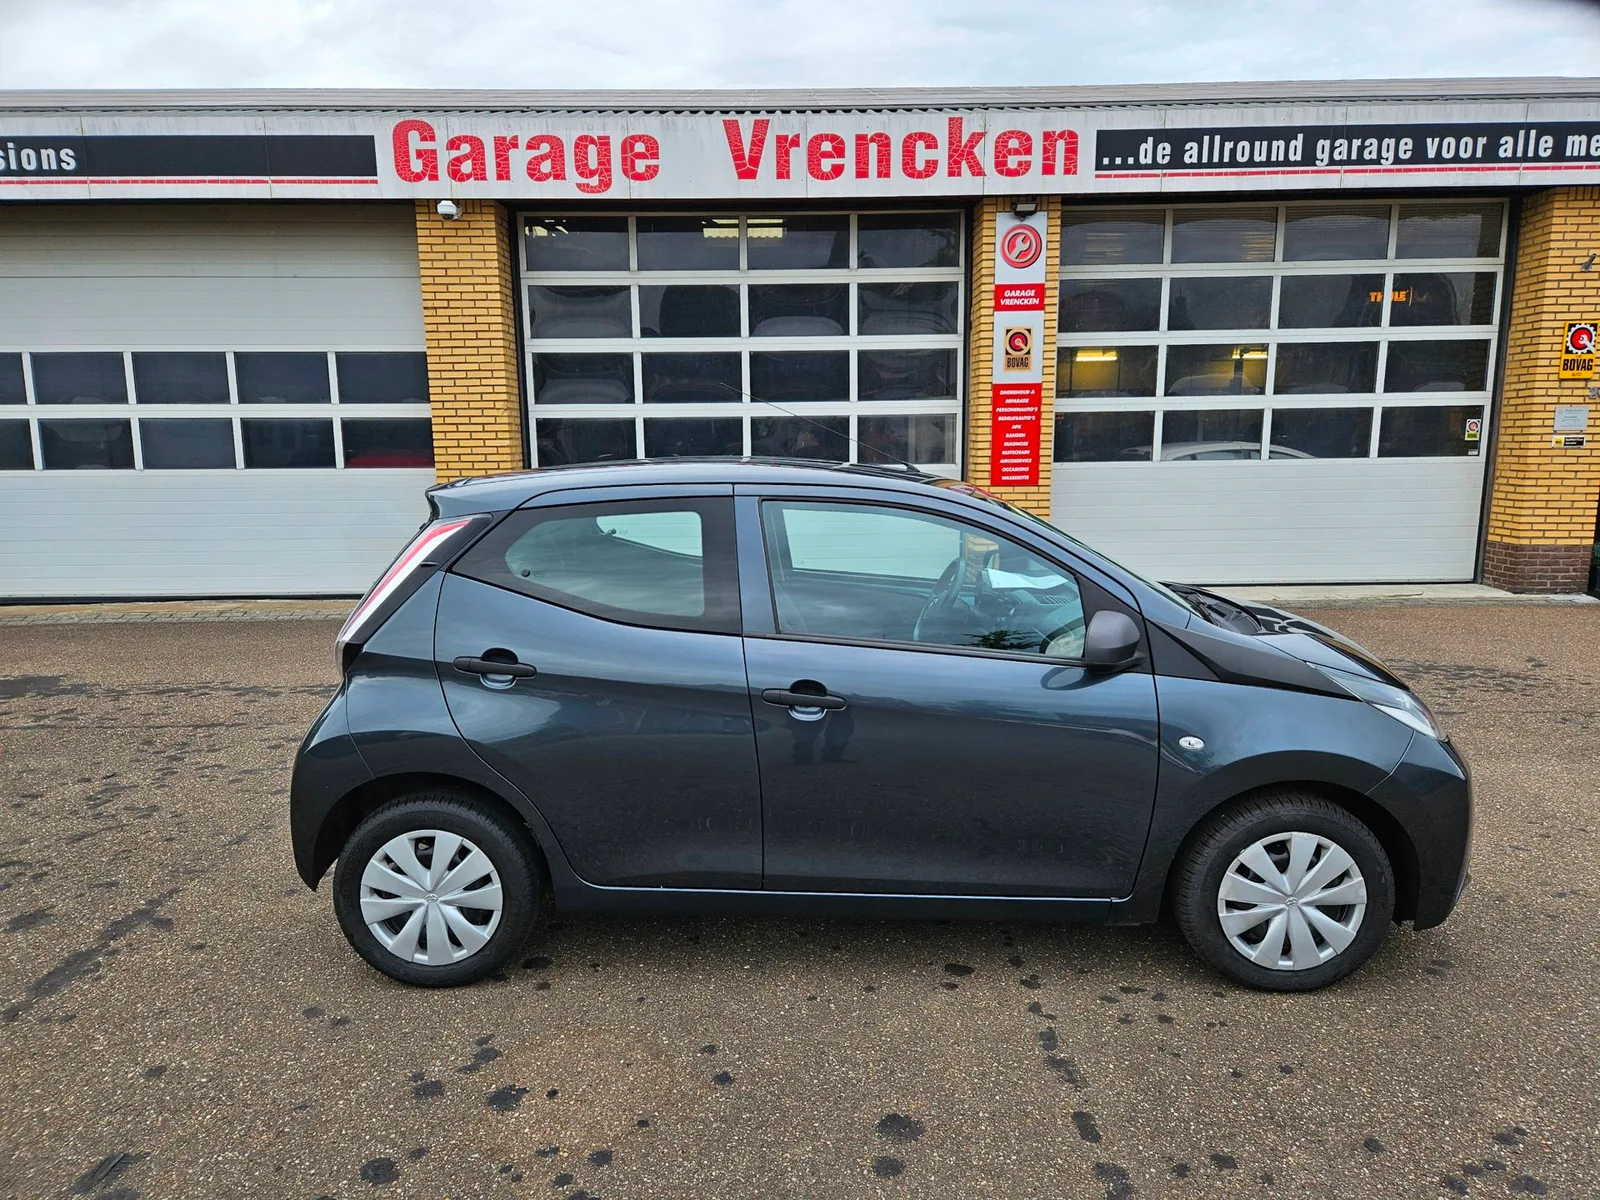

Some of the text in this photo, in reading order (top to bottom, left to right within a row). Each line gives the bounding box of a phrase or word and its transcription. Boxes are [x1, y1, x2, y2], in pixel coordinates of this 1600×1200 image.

[1183, 133, 1304, 164] allround
[1315, 137, 1413, 167] garage
[1426, 136, 1487, 159] voor
[1498, 129, 1554, 158] alle
[392, 117, 1079, 194] Garage Vrencken
[1004, 289, 1036, 298] GARAGE
[1000, 297, 1039, 306] VRENCKEN
[1006, 356, 1029, 368] BOVAG
[1562, 358, 1594, 371] BOVAG
